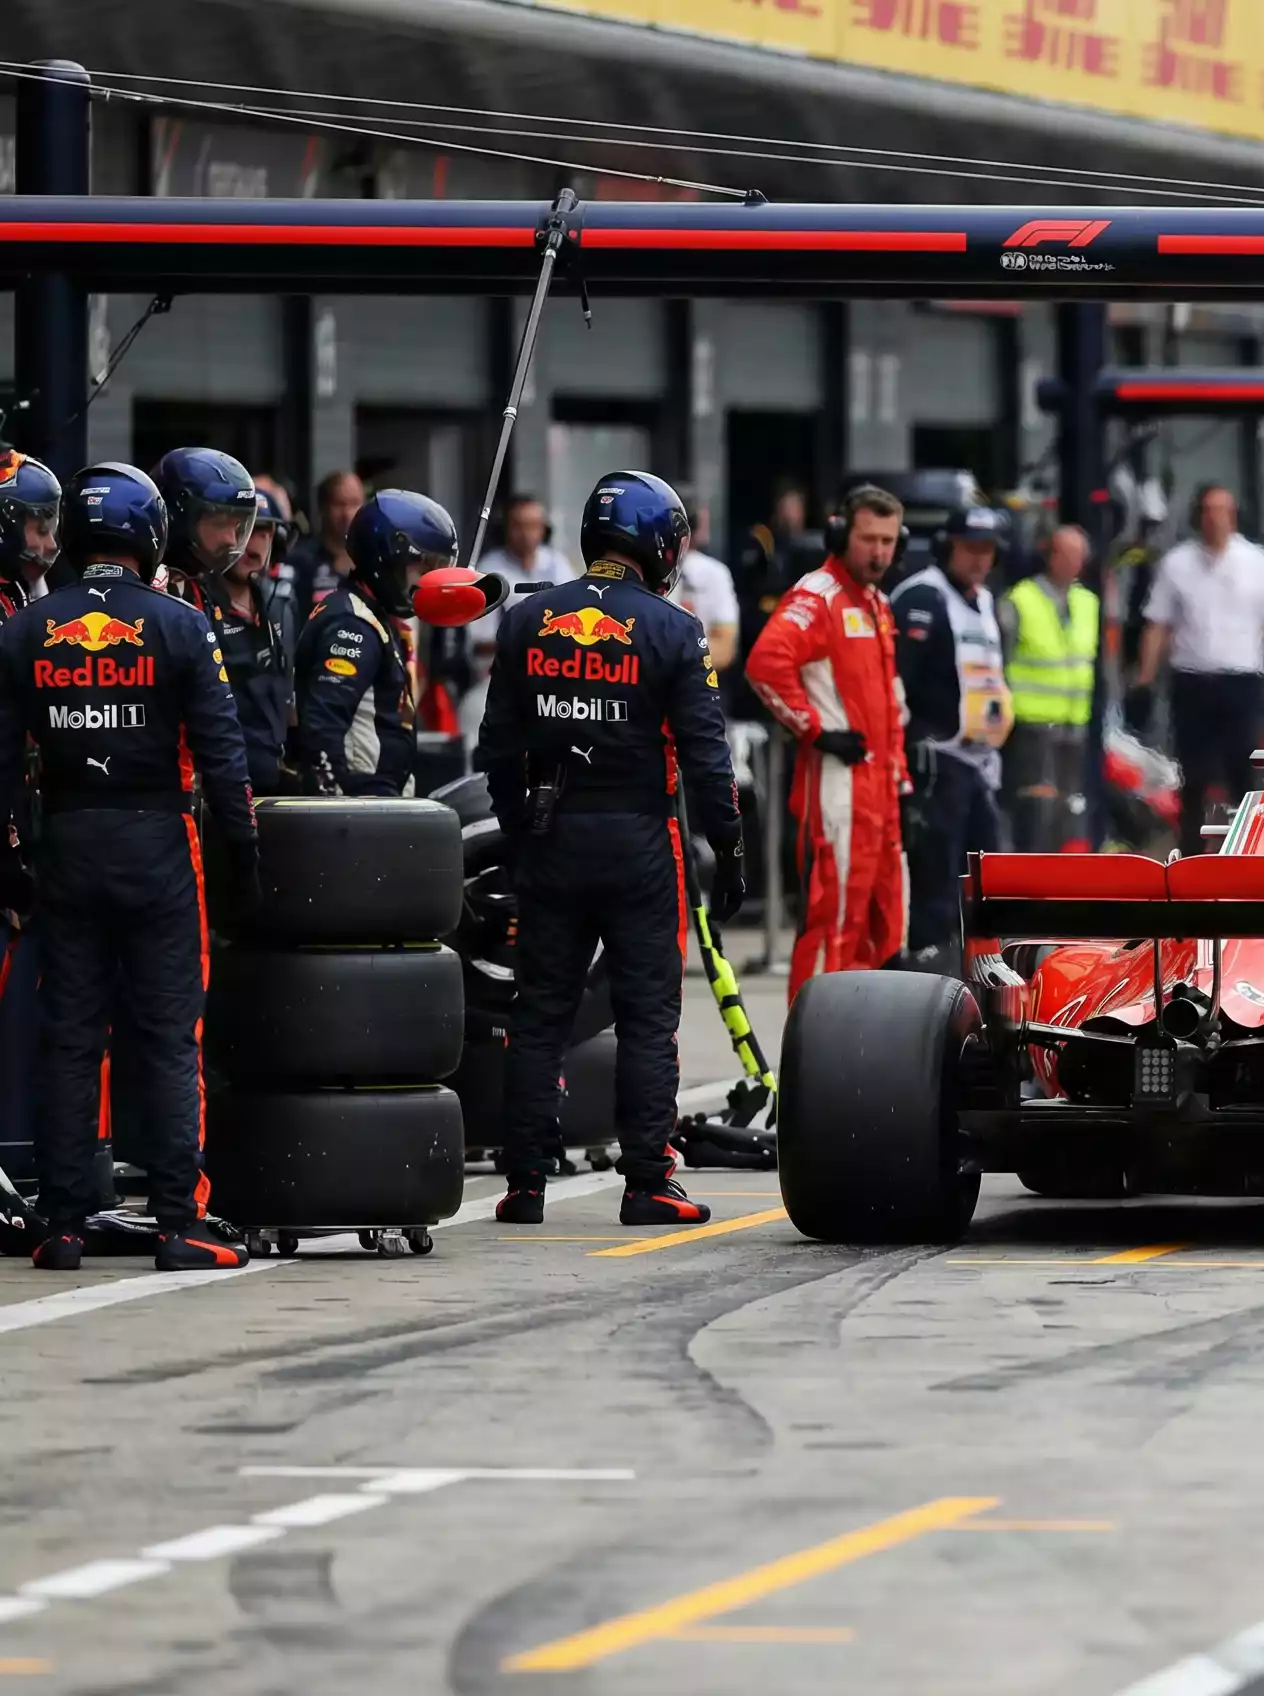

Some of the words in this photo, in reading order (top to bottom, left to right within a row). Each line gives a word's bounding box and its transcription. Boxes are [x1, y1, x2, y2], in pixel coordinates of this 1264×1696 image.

[34, 656, 92, 688] Red
[98, 655, 154, 687] Bull
[527, 648, 582, 679] Red
[585, 651, 639, 685] Bull
[48, 704, 117, 729] Mobil
[537, 694, 602, 721] Mobil
